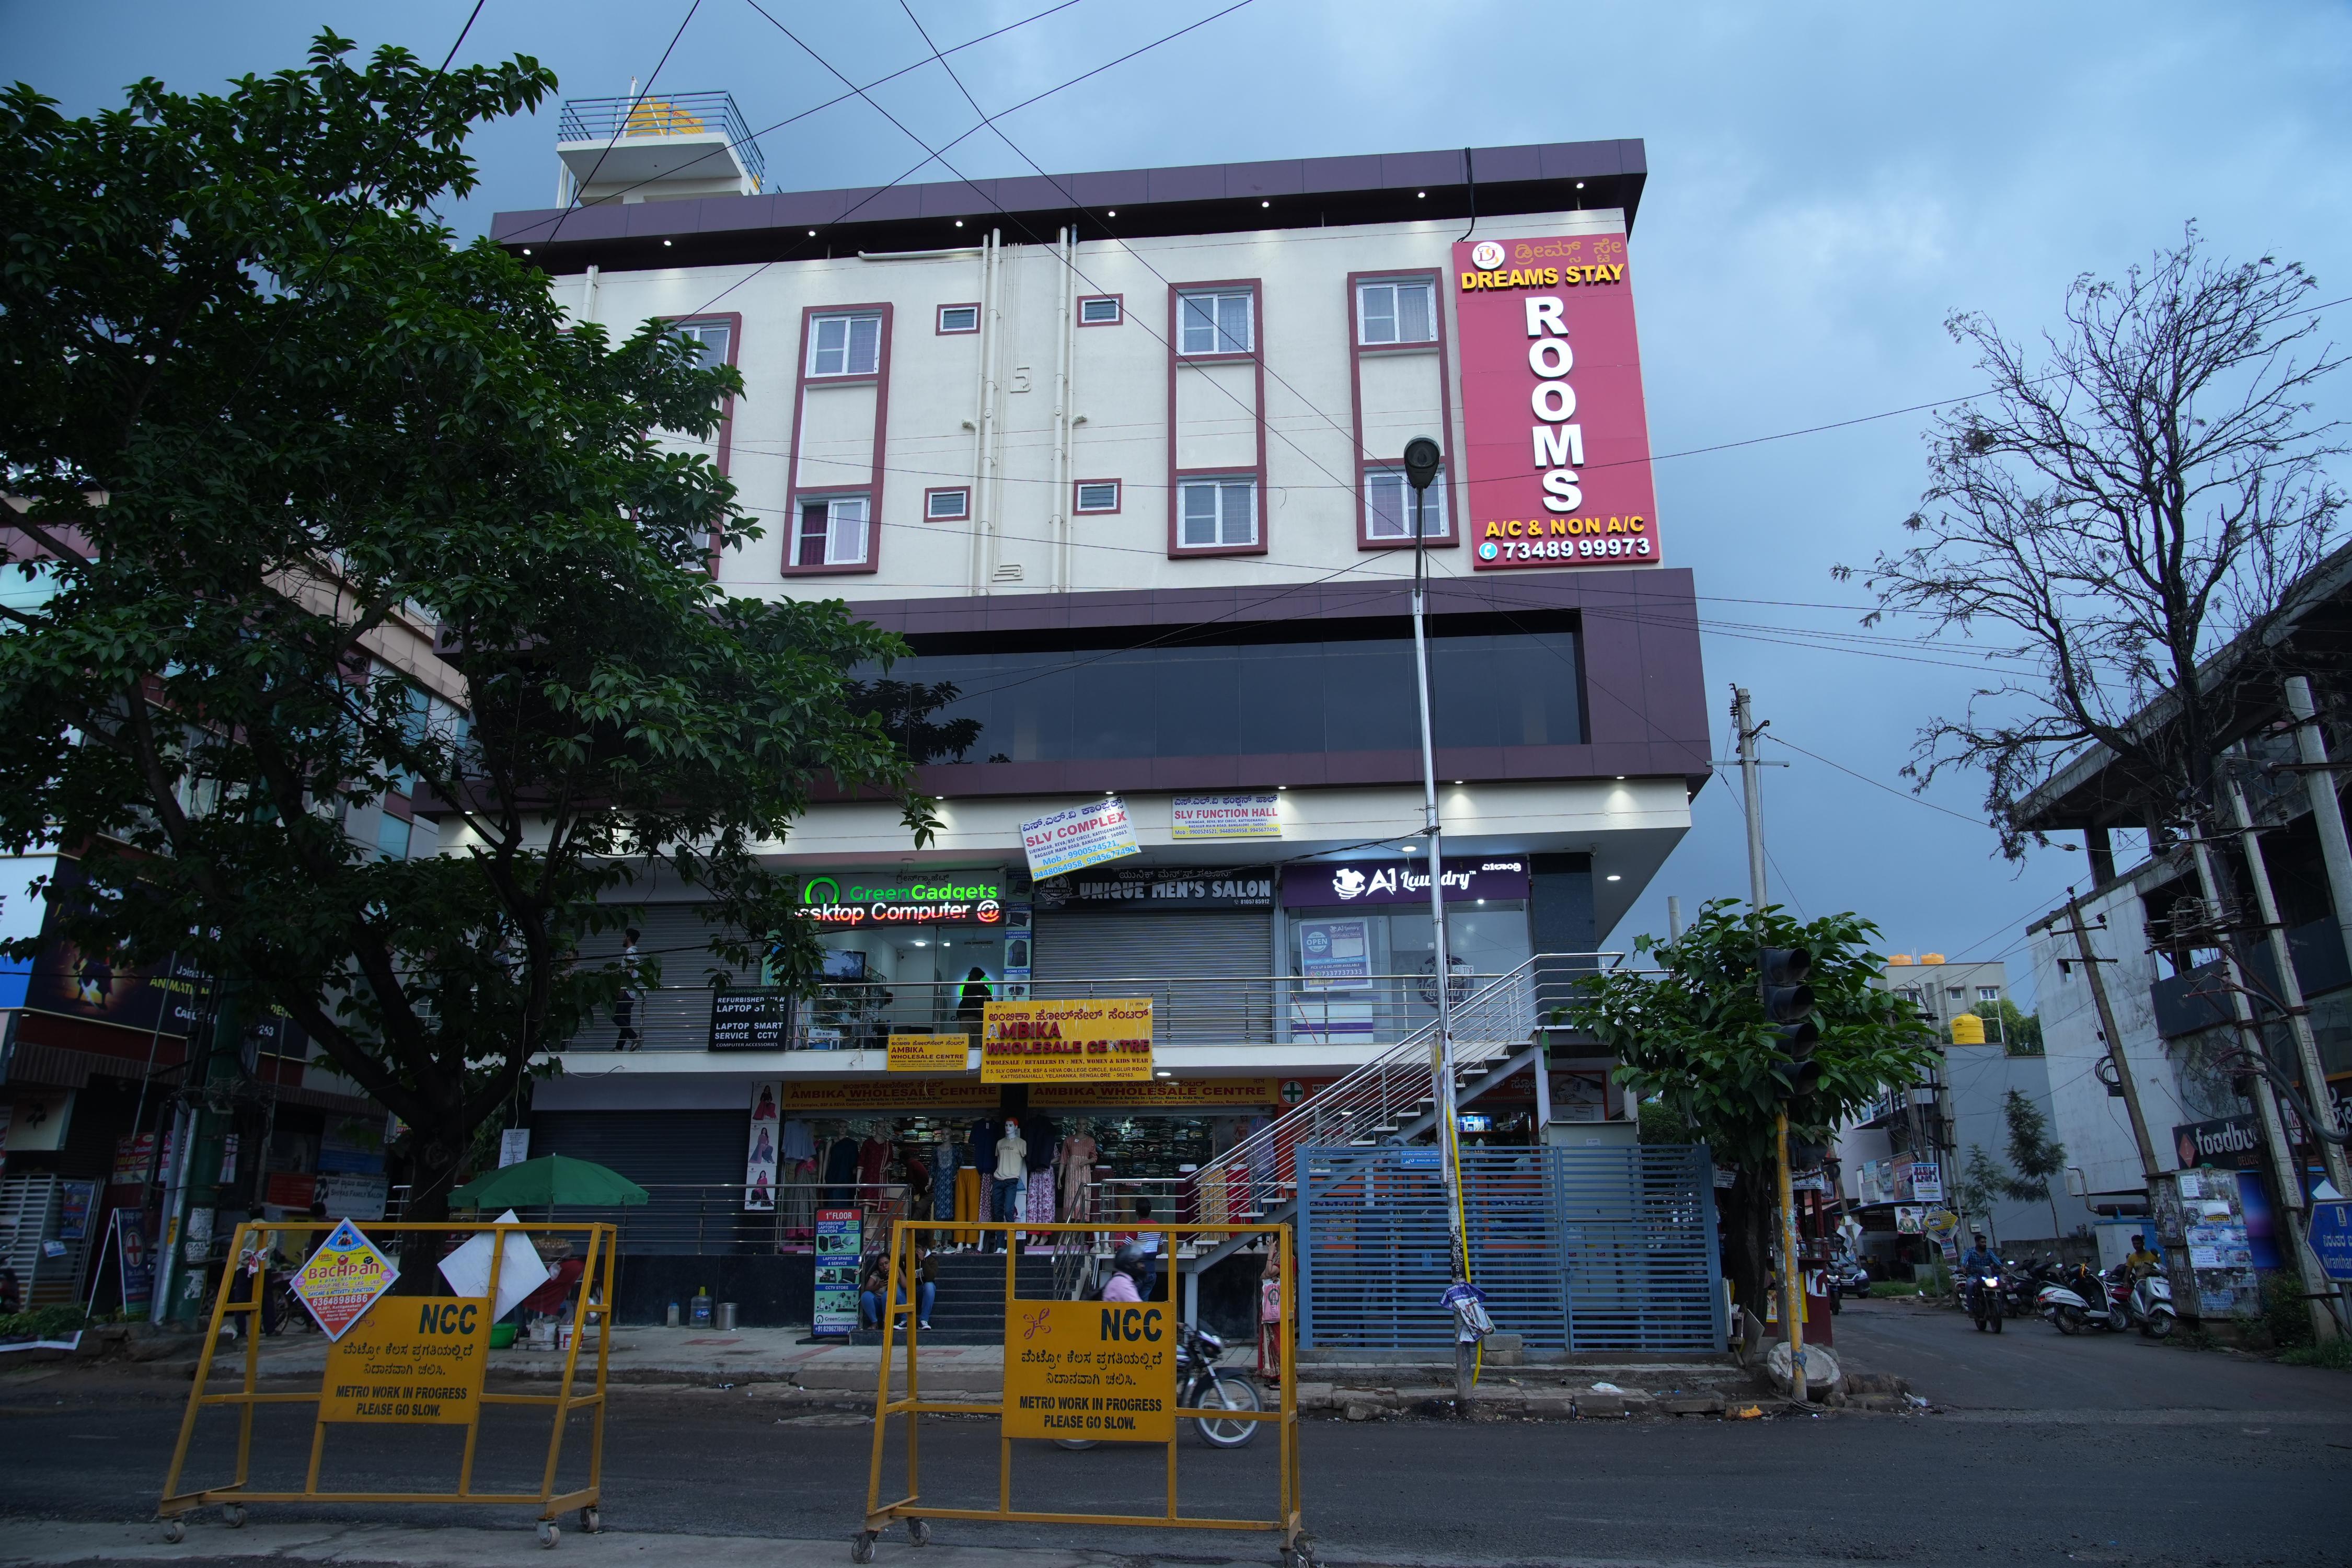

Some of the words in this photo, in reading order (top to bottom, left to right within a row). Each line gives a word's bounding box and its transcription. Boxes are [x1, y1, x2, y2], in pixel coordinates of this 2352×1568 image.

[1461, 267, 1559, 290] DREAMS
[1565, 263, 1624, 284] STAY
[1525, 296, 1584, 512] ROOMS
[1485, 520, 1521, 538] A/C
[1528, 520, 1543, 535] &
[1551, 518, 1600, 535] NON
[1607, 516, 1644, 534] A/C
[1503, 541, 1573, 559] 73489
[1578, 538, 1650, 556] 99973
[1175, 811, 1193, 820] SLV
[1196, 809, 1248, 818] FUNCTION
[1252, 808, 1277, 816] HALL
[1026, 831, 1052, 847] SLV
[1057, 811, 1127, 838] COMPLEX
[1029, 846, 1054, 855] SIRINAGAR,
[1055, 838, 1075, 847] REVA/BSF
[1092, 824, 1128, 837] KATTIGENAHALLI,
[1034, 850, 1054, 859] BAGALUR
[1082, 836, 1107, 846] BANGALORE
[1043, 856, 1062, 866] Mob
[1068, 840, 1119, 859] 9900524521,
[1034, 860, 1085, 879] 9448064958,
[1087, 846, 1135, 864] 9945677490
[1080, 882, 1144, 899] UNIQUE
[1152, 881, 1205, 898] MEN'S
[1212, 880, 1271, 898] SALON
[1366, 868, 1397, 896] A1
[1401, 871, 1470, 892] Laudry
[871, 902, 971, 924] Computer
[988, 1012, 1030, 1021] ಅಂಬಿಕಾ
[1108, 1008, 1148, 1019] ಸೆಂಟರ್
[986, 1021, 1062, 1040] AMBIKA
[986, 1041, 1082, 1055] WHOLESALE
[1087, 1039, 1150, 1053] CENTRE
[790, 1090, 846, 1099] AMBIKA
[849, 1088, 935, 1098] WHOLESALE
[941, 1087, 996, 1096] CENTRE
[1100, 1087, 1197, 1096] WHOLESALE
[313, 1294, 368, 1307] 6364898686
[419, 1304, 477, 1334] NCC
[1101, 1308, 1162, 1342] NCC
[336, 1386, 369, 1398] METRO
[372, 1386, 400, 1398] WORK
[403, 1387, 413, 1398] IN
[416, 1387, 467, 1400] PROGRESS
[1020, 1396, 1055, 1409] METRO
[1058, 1397, 1089, 1410] WORK
[1092, 1397, 1103, 1410] IN
[1106, 1398, 1162, 1411] PROGRESS
[356, 1403, 392, 1415] PLEASE
[395, 1404, 409, 1416] GO
[1044, 1415, 1083, 1428] PLEASE
[1086, 1416, 1101, 1429] GO
